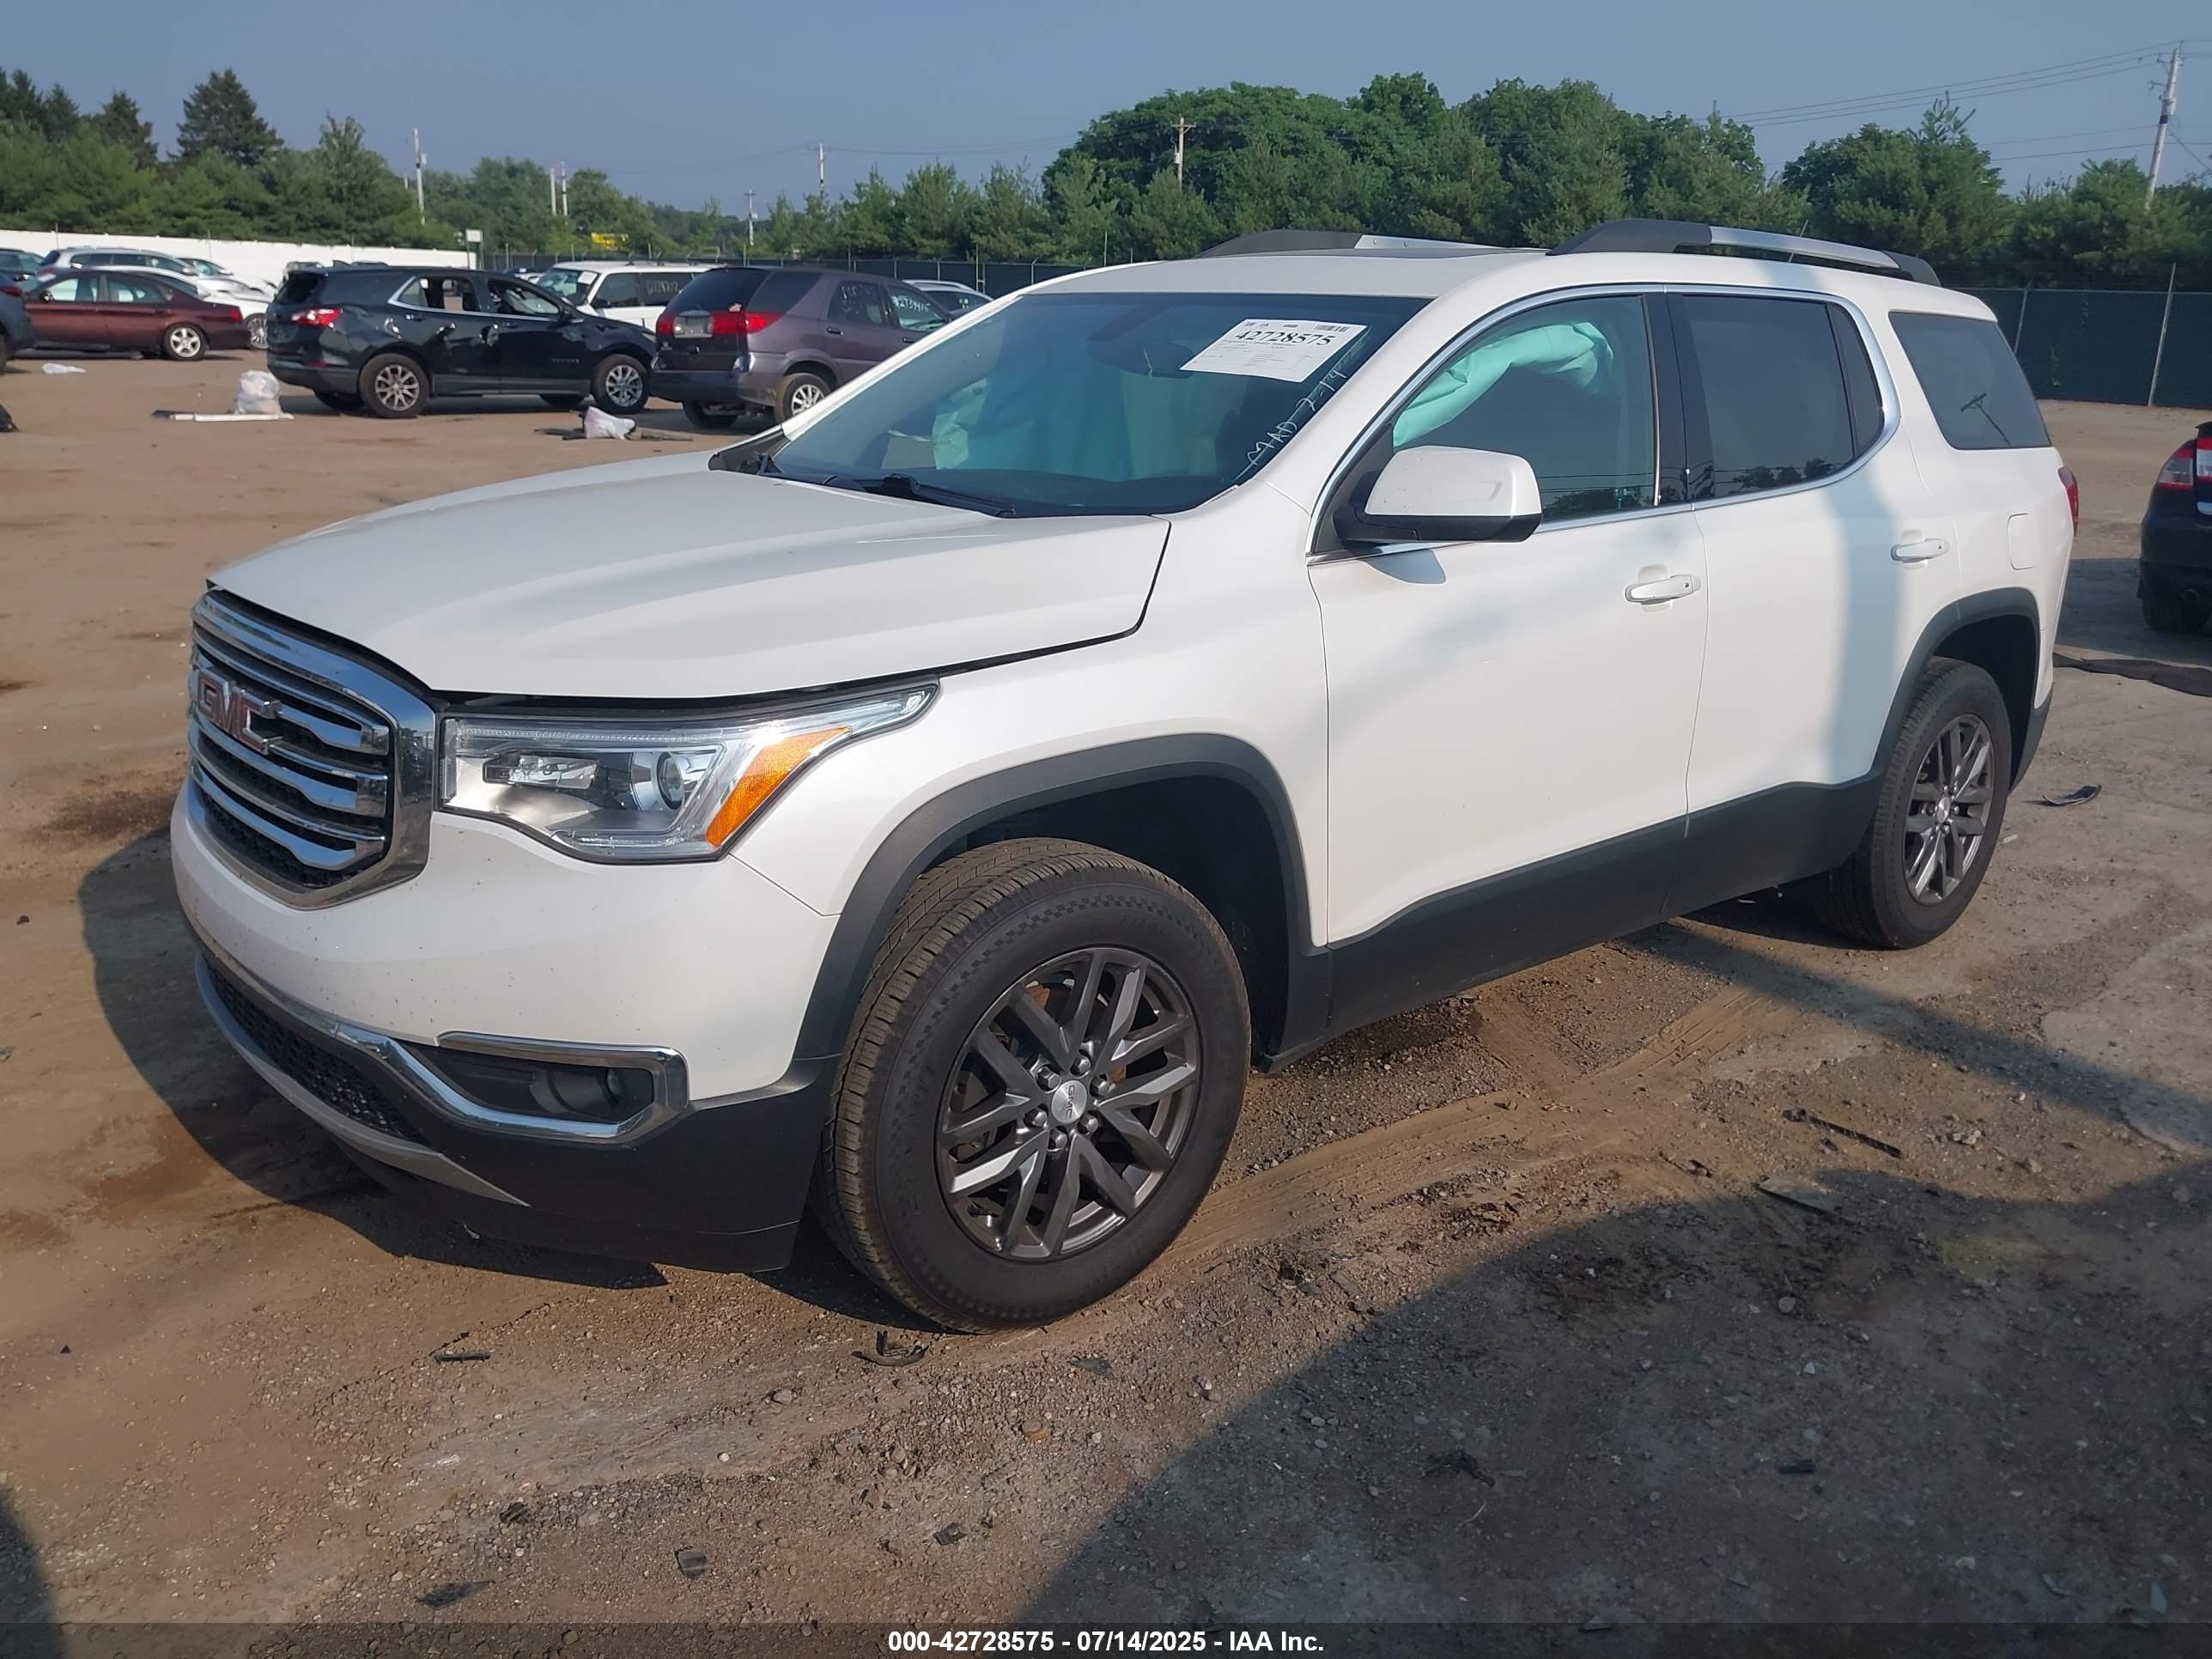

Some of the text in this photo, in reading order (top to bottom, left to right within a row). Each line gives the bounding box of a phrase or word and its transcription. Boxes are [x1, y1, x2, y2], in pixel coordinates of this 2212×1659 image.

[1236, 330, 1335, 346] 42728575
[1247, 421, 1297, 465] MAD
[191, 668, 276, 755] GMC
[1066, 1085, 1076, 1120] GMC
